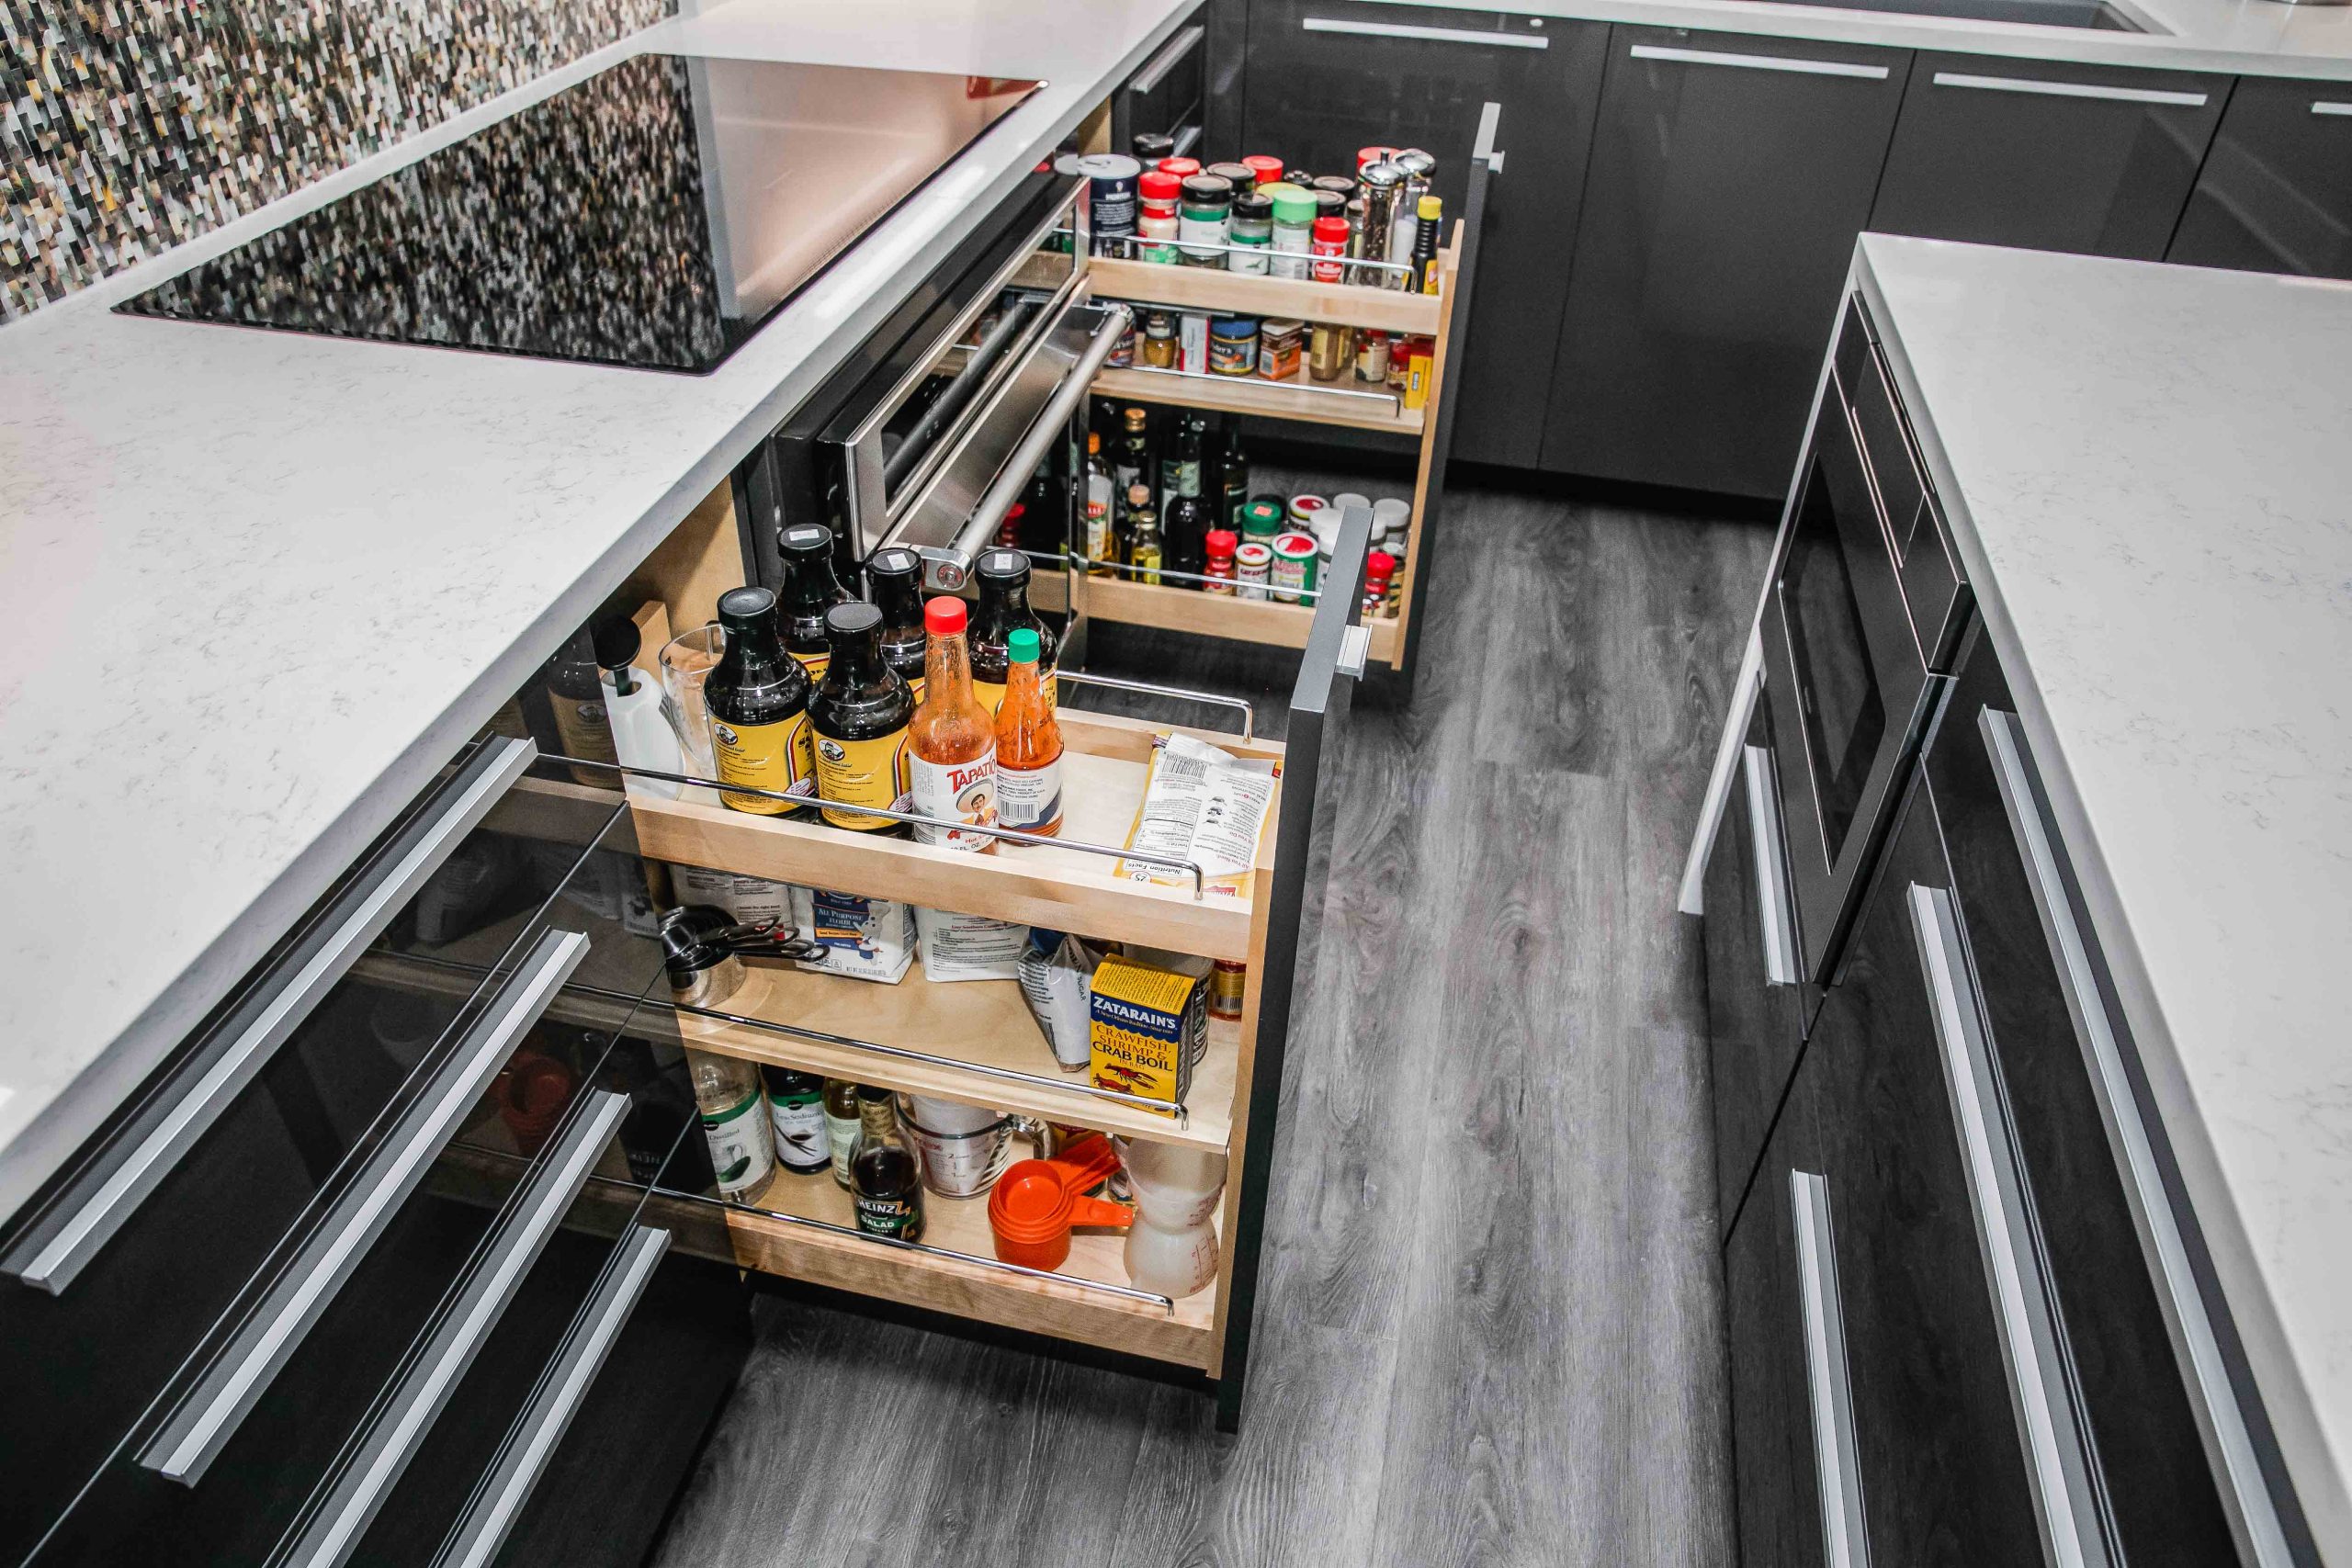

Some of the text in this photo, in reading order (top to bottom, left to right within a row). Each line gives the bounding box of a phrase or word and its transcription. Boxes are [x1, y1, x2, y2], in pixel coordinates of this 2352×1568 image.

[1150, 866, 1181, 874] Nutrition
[831, 909, 863, 921] PURPOSE
[1077, 976, 1086, 1001] SUGAR
[1093, 996, 1176, 1029] ZATARAIN'S
[1096, 1024, 1171, 1054] CRAWFISH,
[1100, 1035, 1167, 1060] SHRIMP &
[1092, 1041, 1173, 1072] CRAB BOIL
[858, 1199, 896, 1213] HEINZ
[861, 1214, 895, 1228] SALAD
